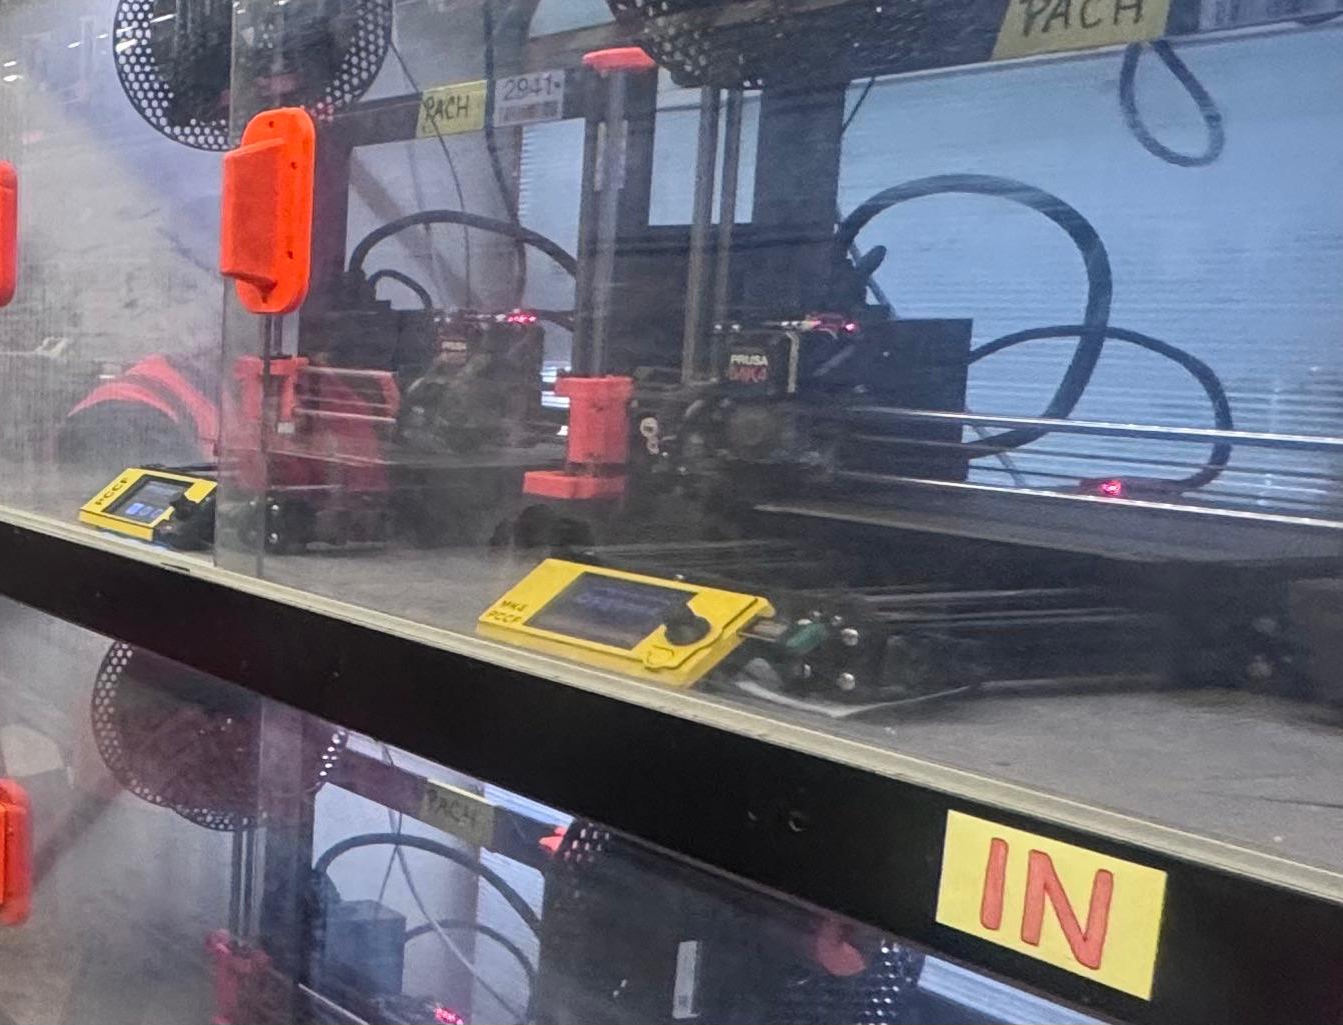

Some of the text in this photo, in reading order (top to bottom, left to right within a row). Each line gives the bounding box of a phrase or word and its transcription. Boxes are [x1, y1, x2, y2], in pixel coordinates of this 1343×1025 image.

[422, 94, 471, 122] PACH
[730, 354, 768, 366] PRUSA
[980, 837, 1114, 971] IN
